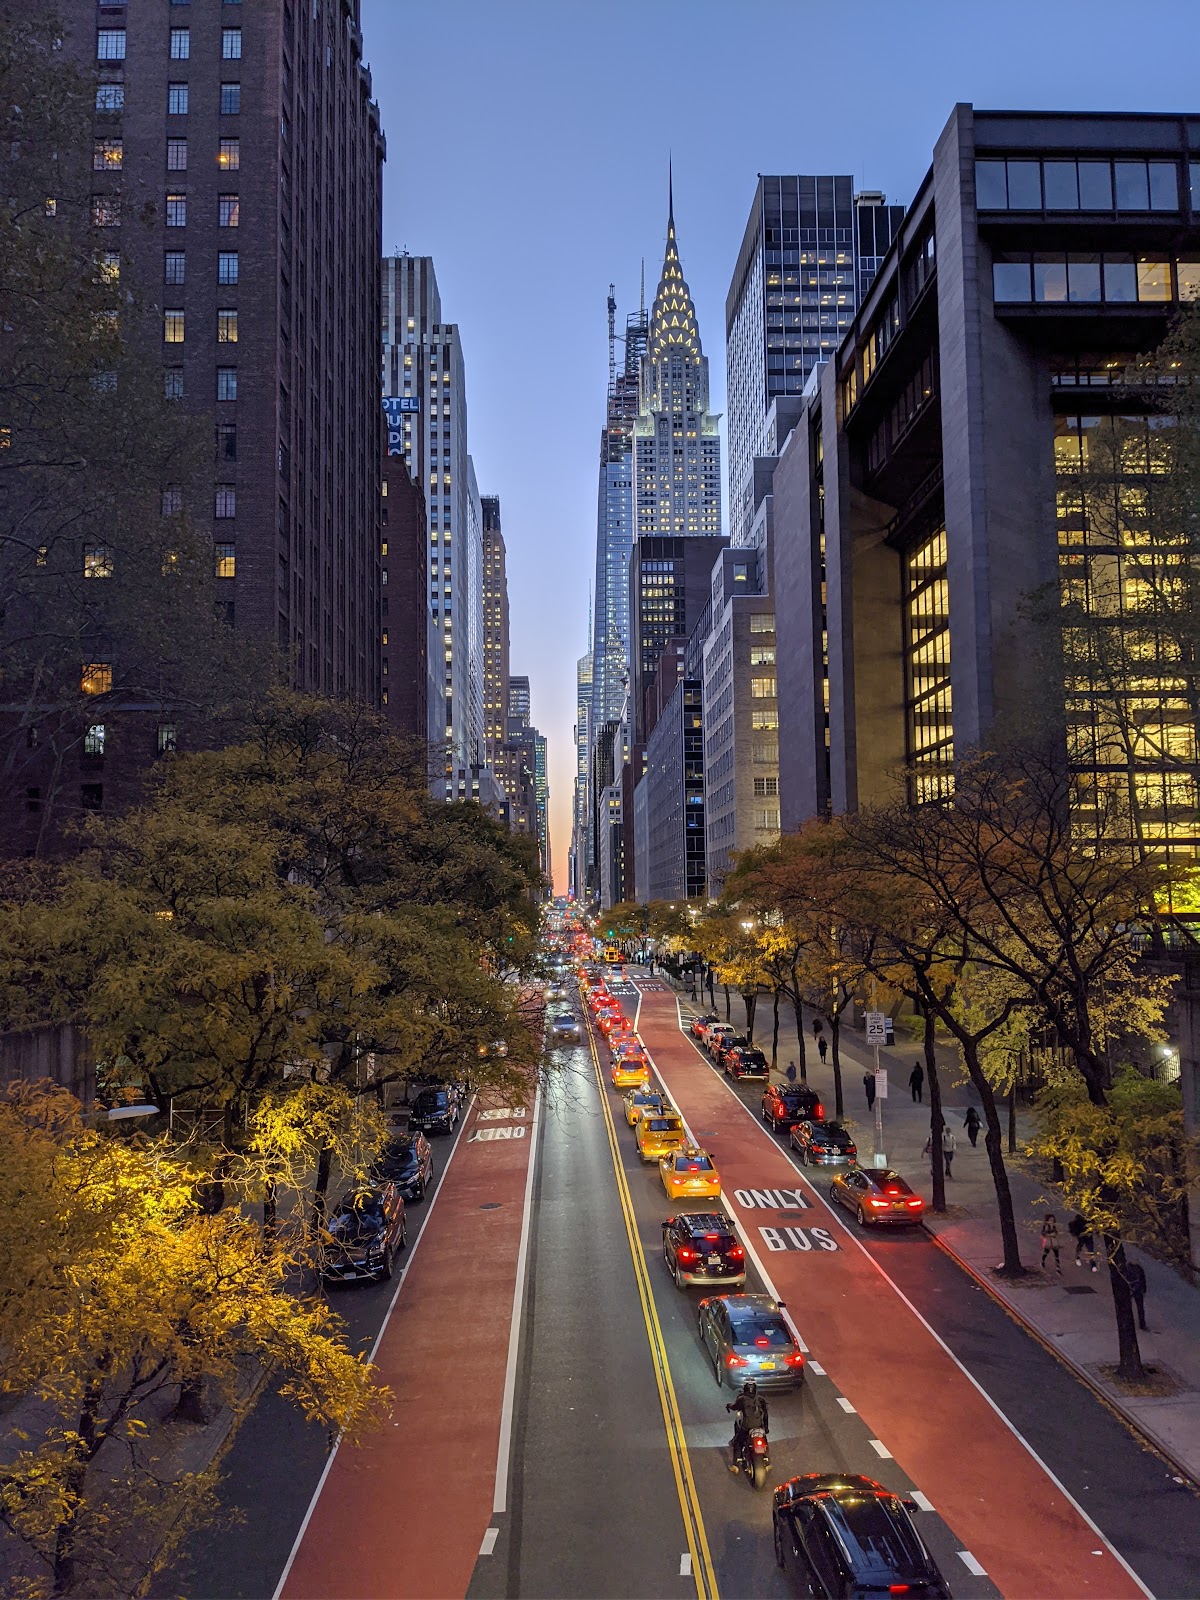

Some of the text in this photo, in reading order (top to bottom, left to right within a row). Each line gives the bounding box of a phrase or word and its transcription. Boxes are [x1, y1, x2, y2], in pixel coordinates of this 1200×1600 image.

[869, 1024, 884, 1034] 25
[733, 1188, 808, 1209] ONLY
[757, 1226, 838, 1251] BUS
